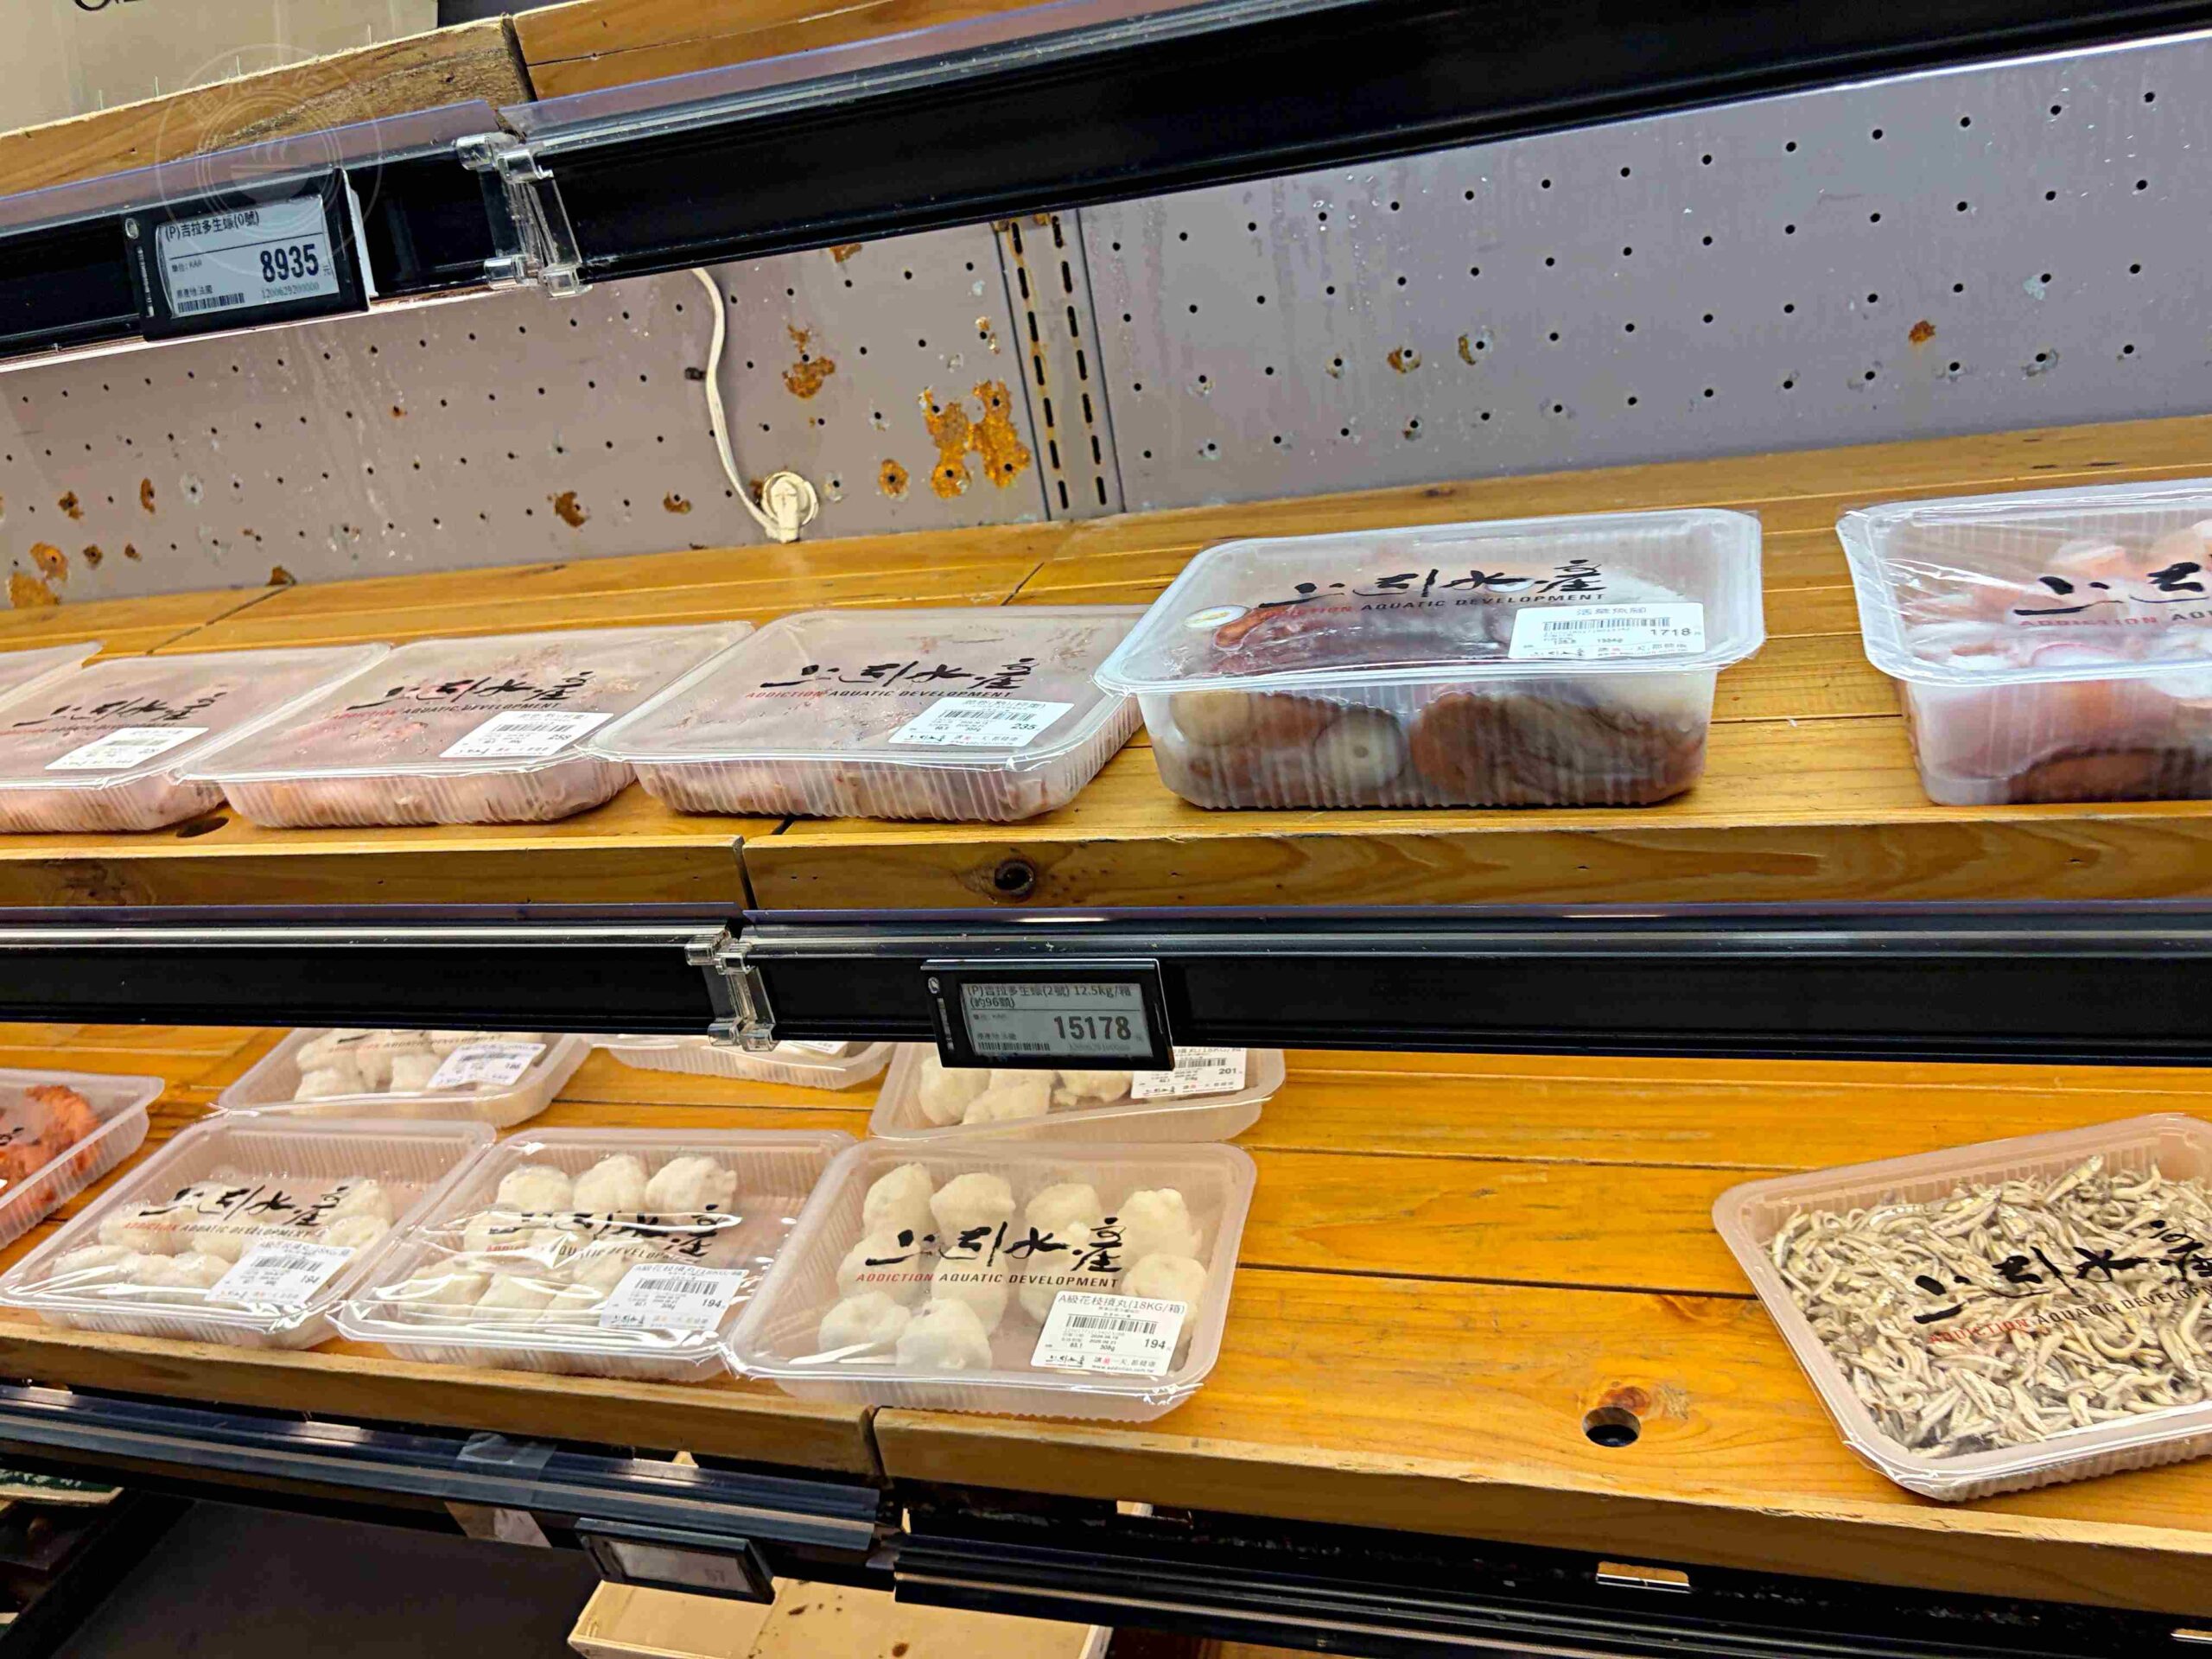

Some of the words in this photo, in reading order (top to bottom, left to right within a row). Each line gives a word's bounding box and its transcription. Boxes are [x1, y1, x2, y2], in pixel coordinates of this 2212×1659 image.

[259, 244, 320, 283] 8935
[1361, 601, 1446, 611] AQUATIC
[1456, 593, 1605, 607] DEVELOPMENT
[1650, 627, 1691, 637] 1718
[1053, 1015, 1132, 1040] 15178
[864, 1217, 1128, 1273] 上引水產
[855, 1273, 934, 1283] ADDICTION
[938, 1273, 1003, 1284] AQUATIC
[1008, 1274, 1121, 1288] DEVELOPMENT
[701, 1298, 722, 1308] 194
[1928, 1319, 2028, 1344] ADDICTION
[2035, 1301, 2117, 1326] AQUATIC
[1143, 1338, 1166, 1351] 194
